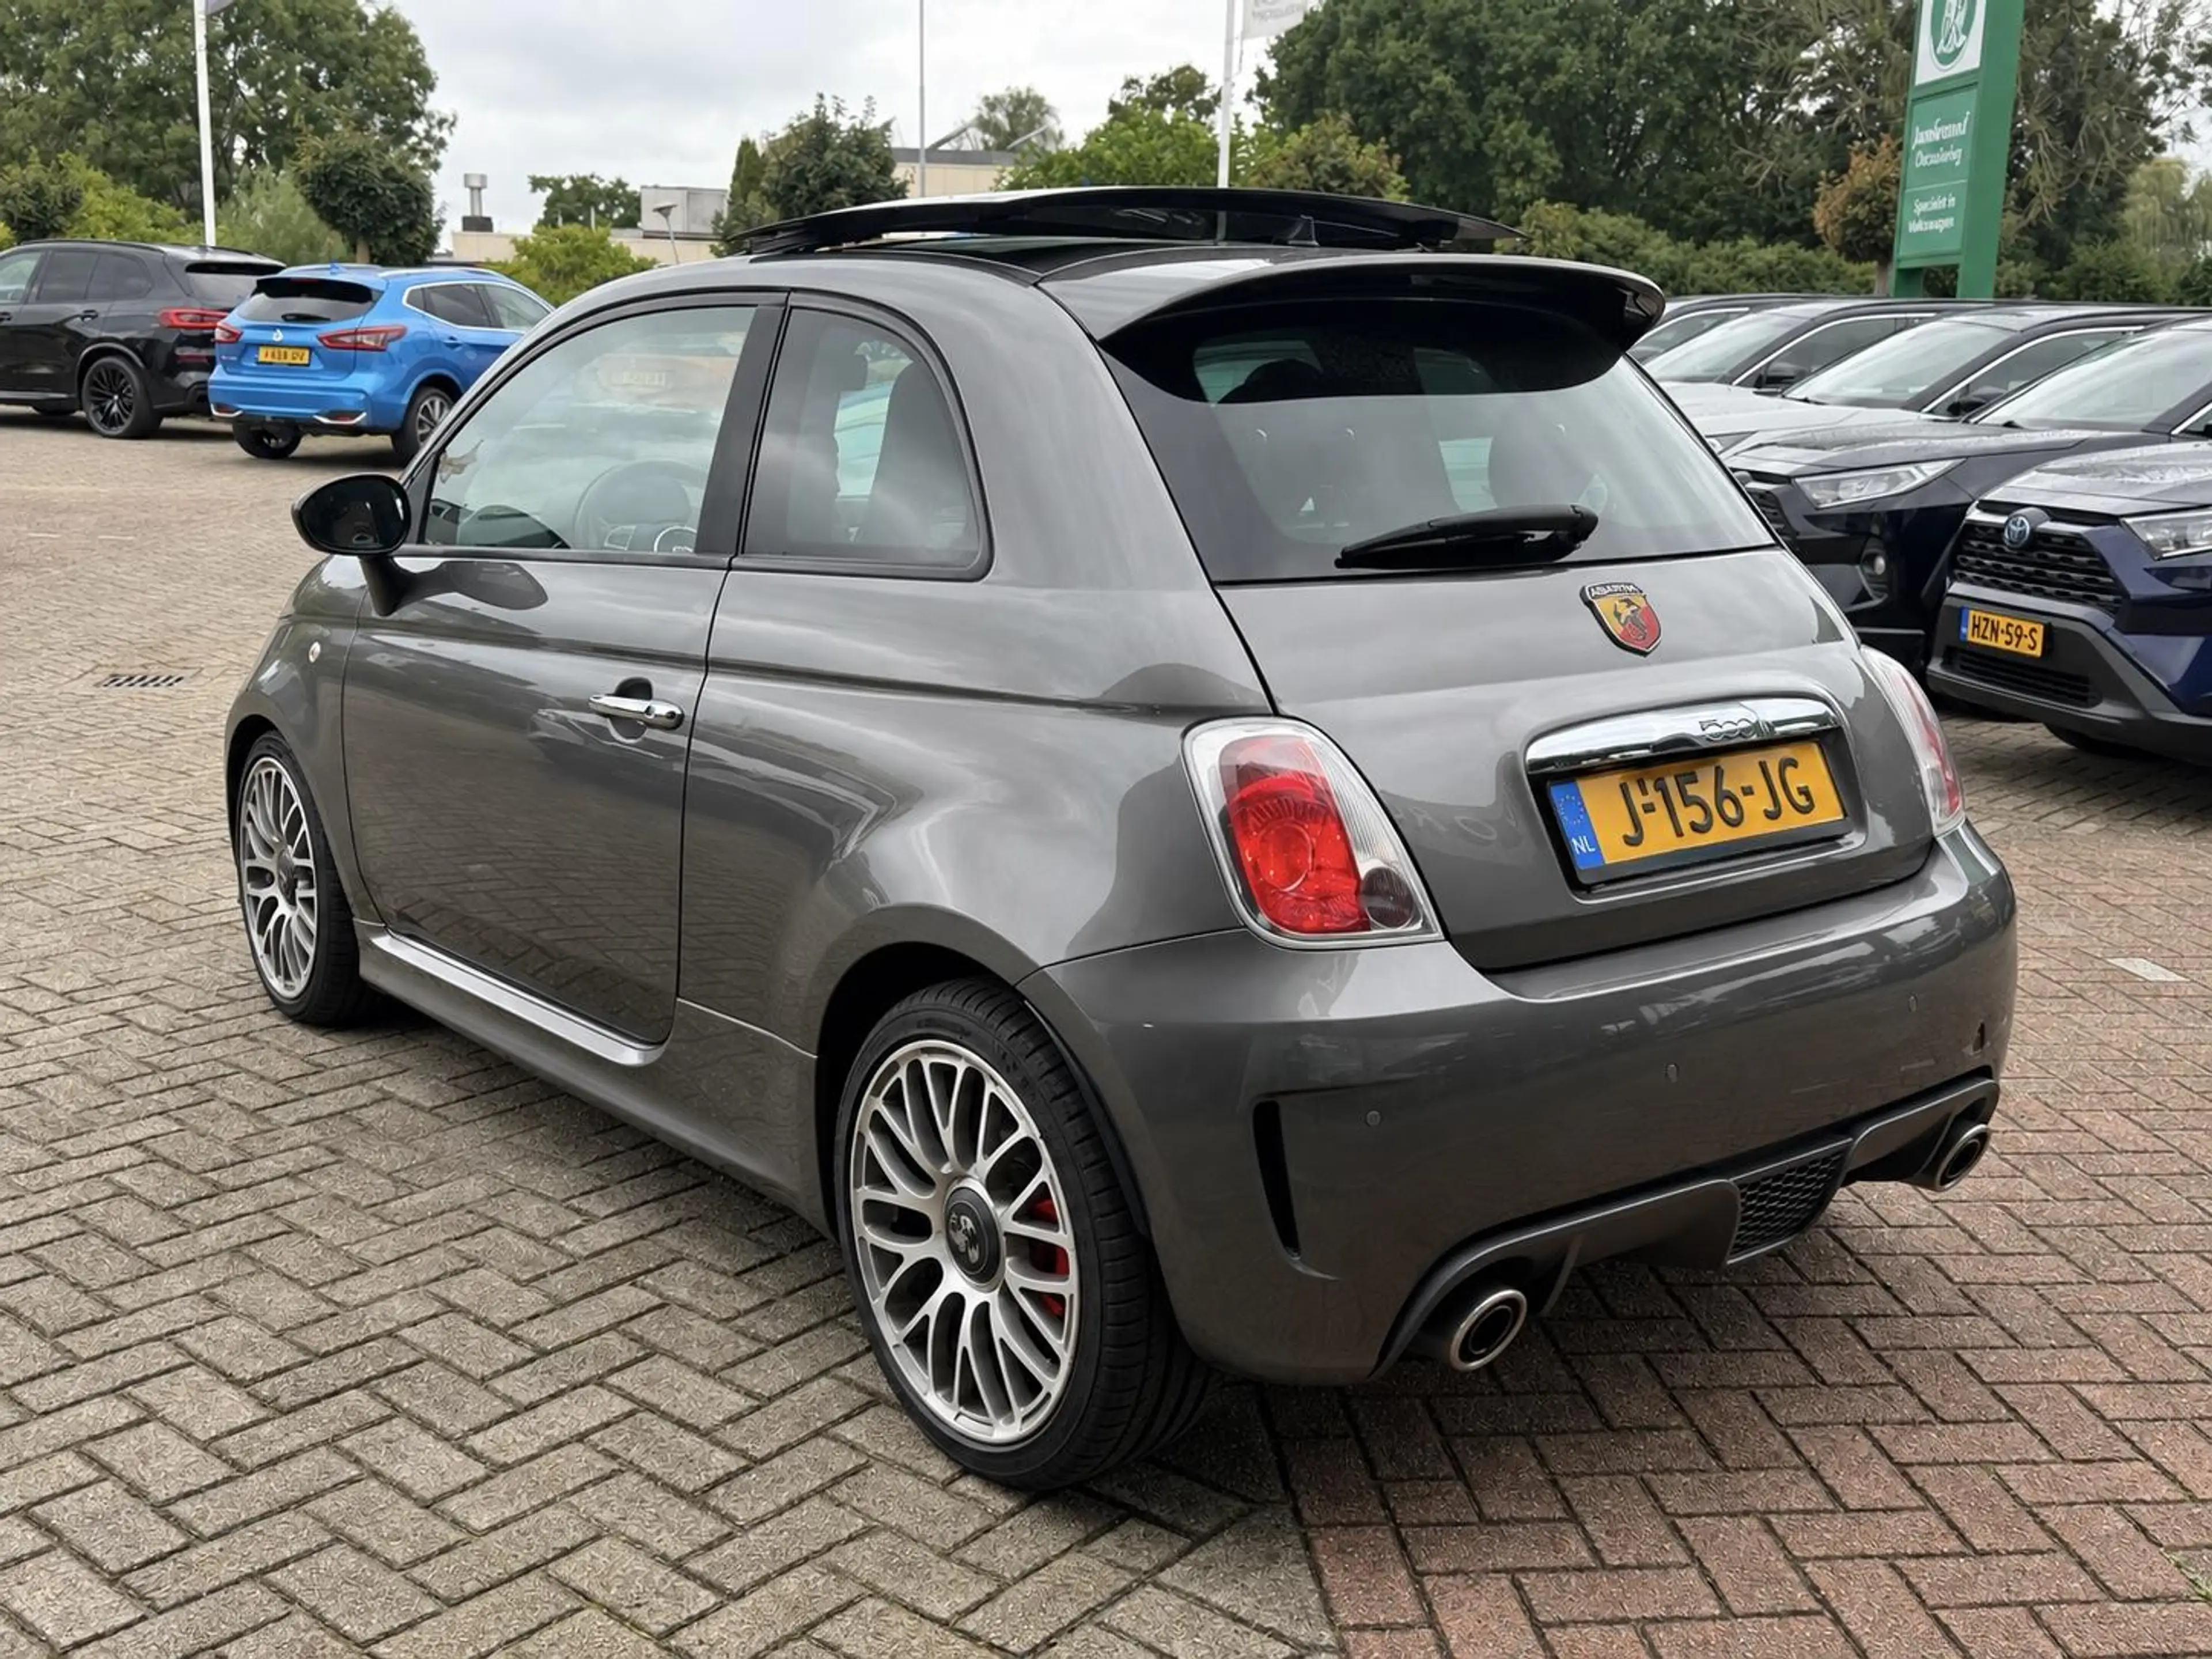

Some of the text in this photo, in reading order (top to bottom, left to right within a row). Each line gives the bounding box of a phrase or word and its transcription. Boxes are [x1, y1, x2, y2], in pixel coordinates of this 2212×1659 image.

[1971, 614, 2038, 651] HZN-59-S
[1619, 757, 1816, 847] J-156-JG
[1571, 835, 1596, 854] NL
